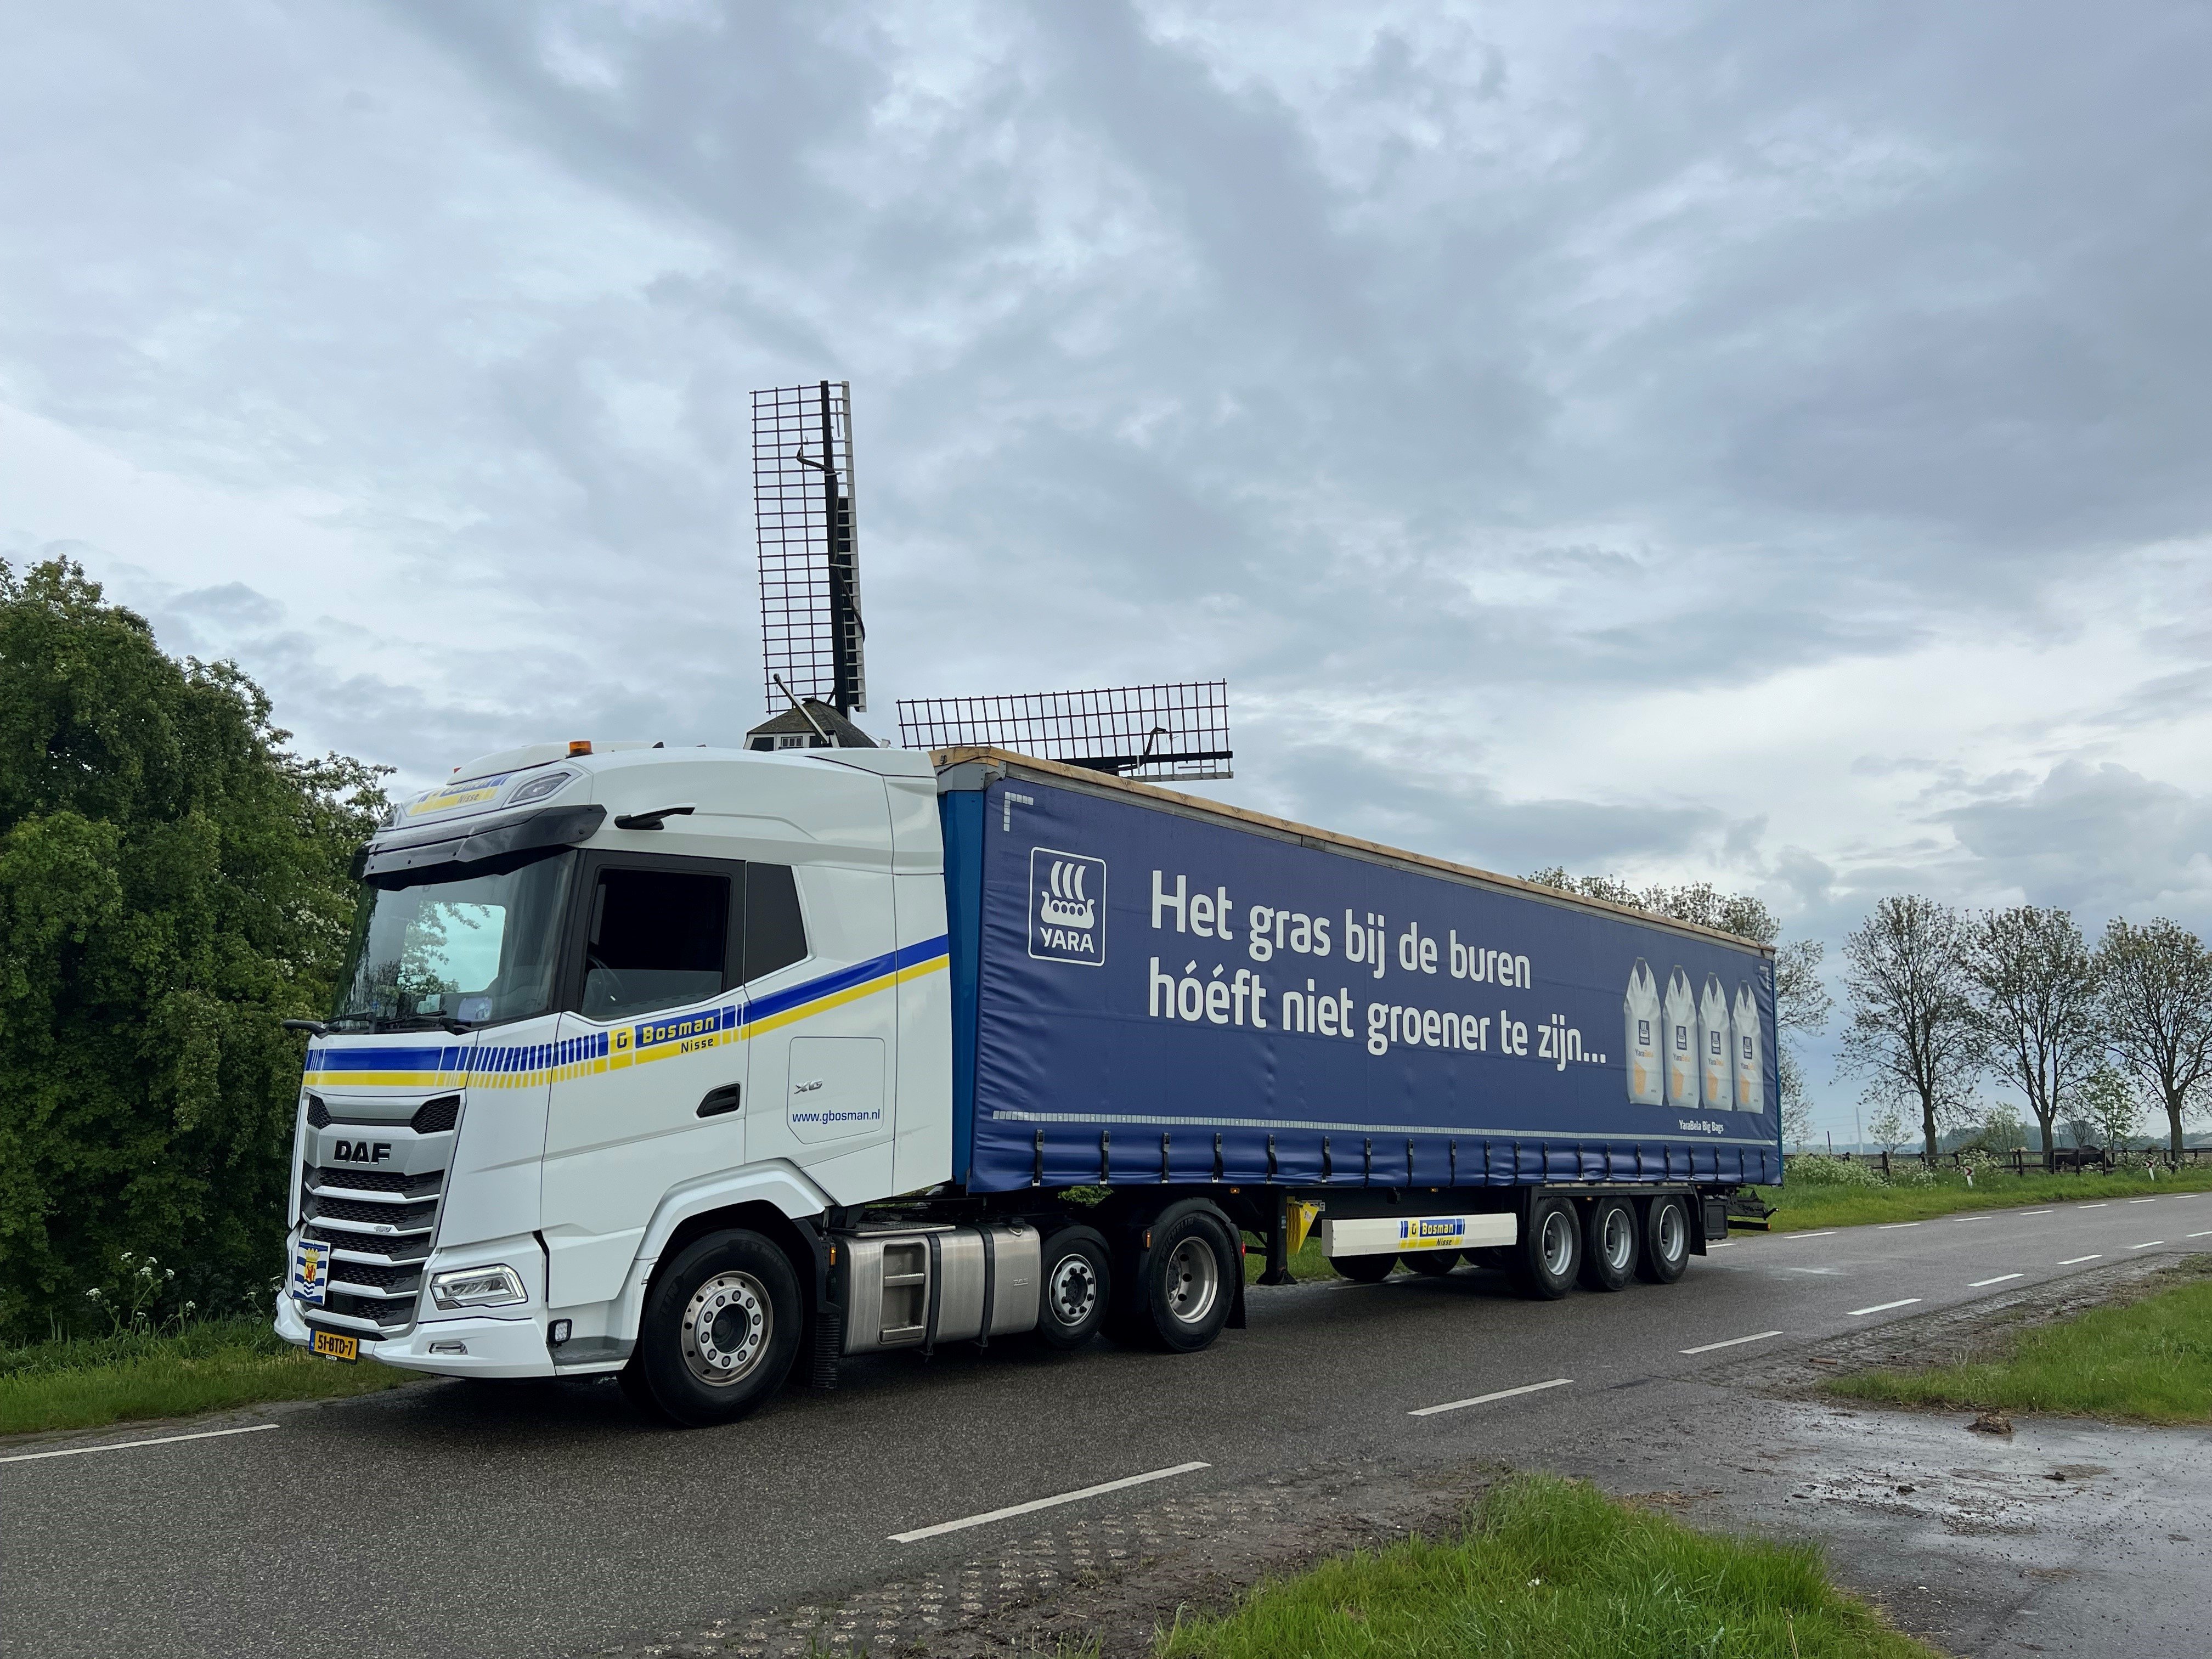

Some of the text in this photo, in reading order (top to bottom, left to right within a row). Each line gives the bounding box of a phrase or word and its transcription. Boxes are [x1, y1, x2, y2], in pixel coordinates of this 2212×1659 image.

[456, 793, 480, 804] Nisse
[1152, 870, 1531, 989] Het gras bij de buren
[1040, 927, 1094, 953] YARA
[1150, 956, 1606, 1071] hóéft niet groener te zijn...
[642, 1017, 714, 1044] Bosman
[681, 1038, 714, 1053] Nisse
[794, 1079, 823, 1094] XG
[792, 1109, 880, 1124] www.gbosman.nl
[1679, 1119, 1724, 1134] YaraBela Big Bags
[334, 1139, 392, 1165] DAF
[1422, 1222, 1454, 1235] Bosman
[1436, 1238, 1452, 1246] Nisse
[318, 1334, 353, 1356] 51-BTD-7
